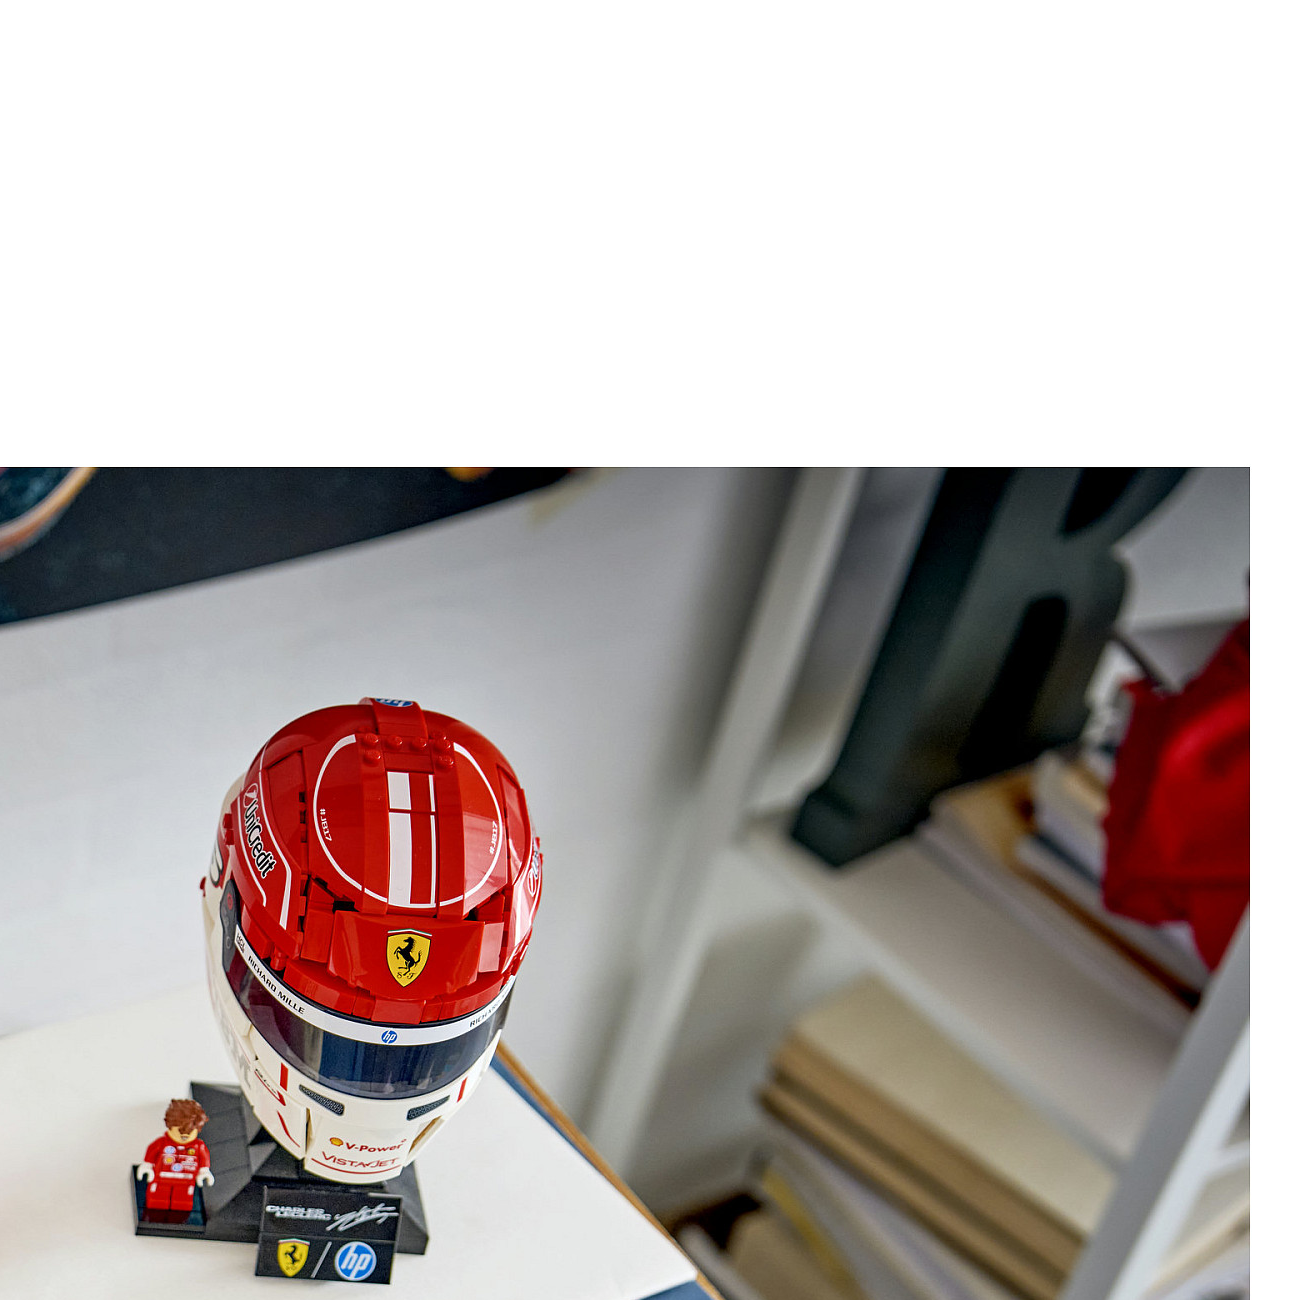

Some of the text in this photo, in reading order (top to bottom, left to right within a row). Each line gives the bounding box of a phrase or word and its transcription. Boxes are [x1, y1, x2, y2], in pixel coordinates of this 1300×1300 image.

[244, 799, 276, 879] UniCredit
[319, 808, 333, 842] #JB17
[248, 955, 306, 1015] RICHARD MILLE
[382, 1030, 397, 1044] hp
[321, 1151, 399, 1168] VISTAJET
[340, 1242, 373, 1280] hp
